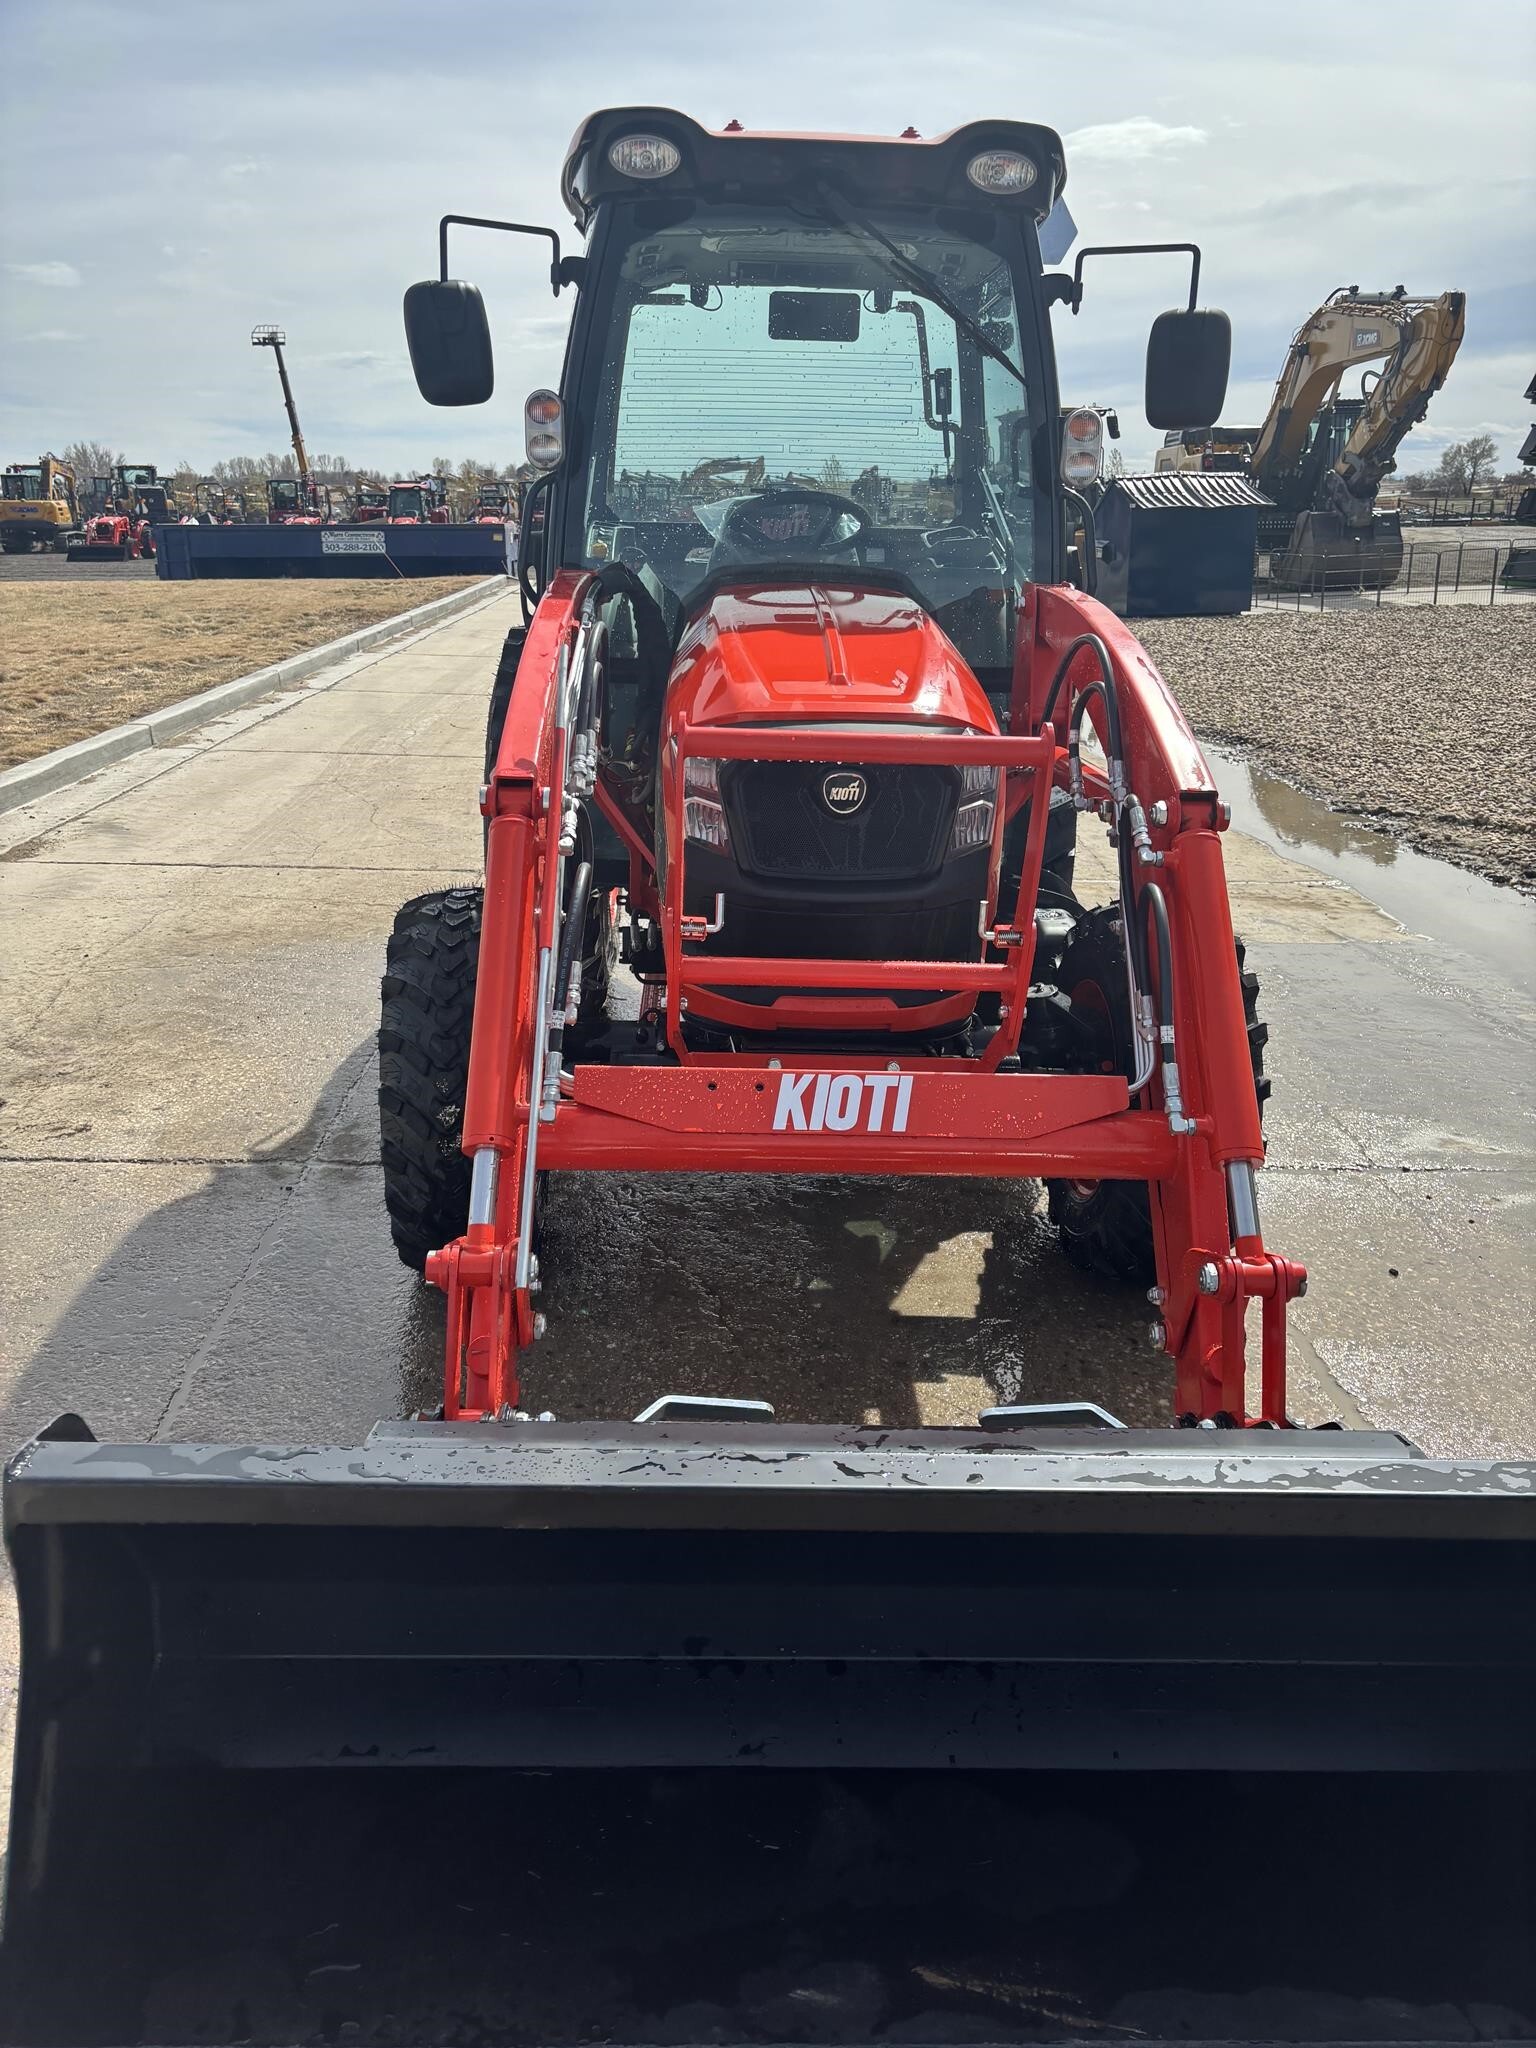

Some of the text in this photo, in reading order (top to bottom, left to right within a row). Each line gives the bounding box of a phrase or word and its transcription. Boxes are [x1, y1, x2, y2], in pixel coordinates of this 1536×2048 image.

[324, 543, 385, 552] 303-288-2100
[829, 786, 860, 801] KIOTI
[772, 1073, 914, 1132] KIOTI
